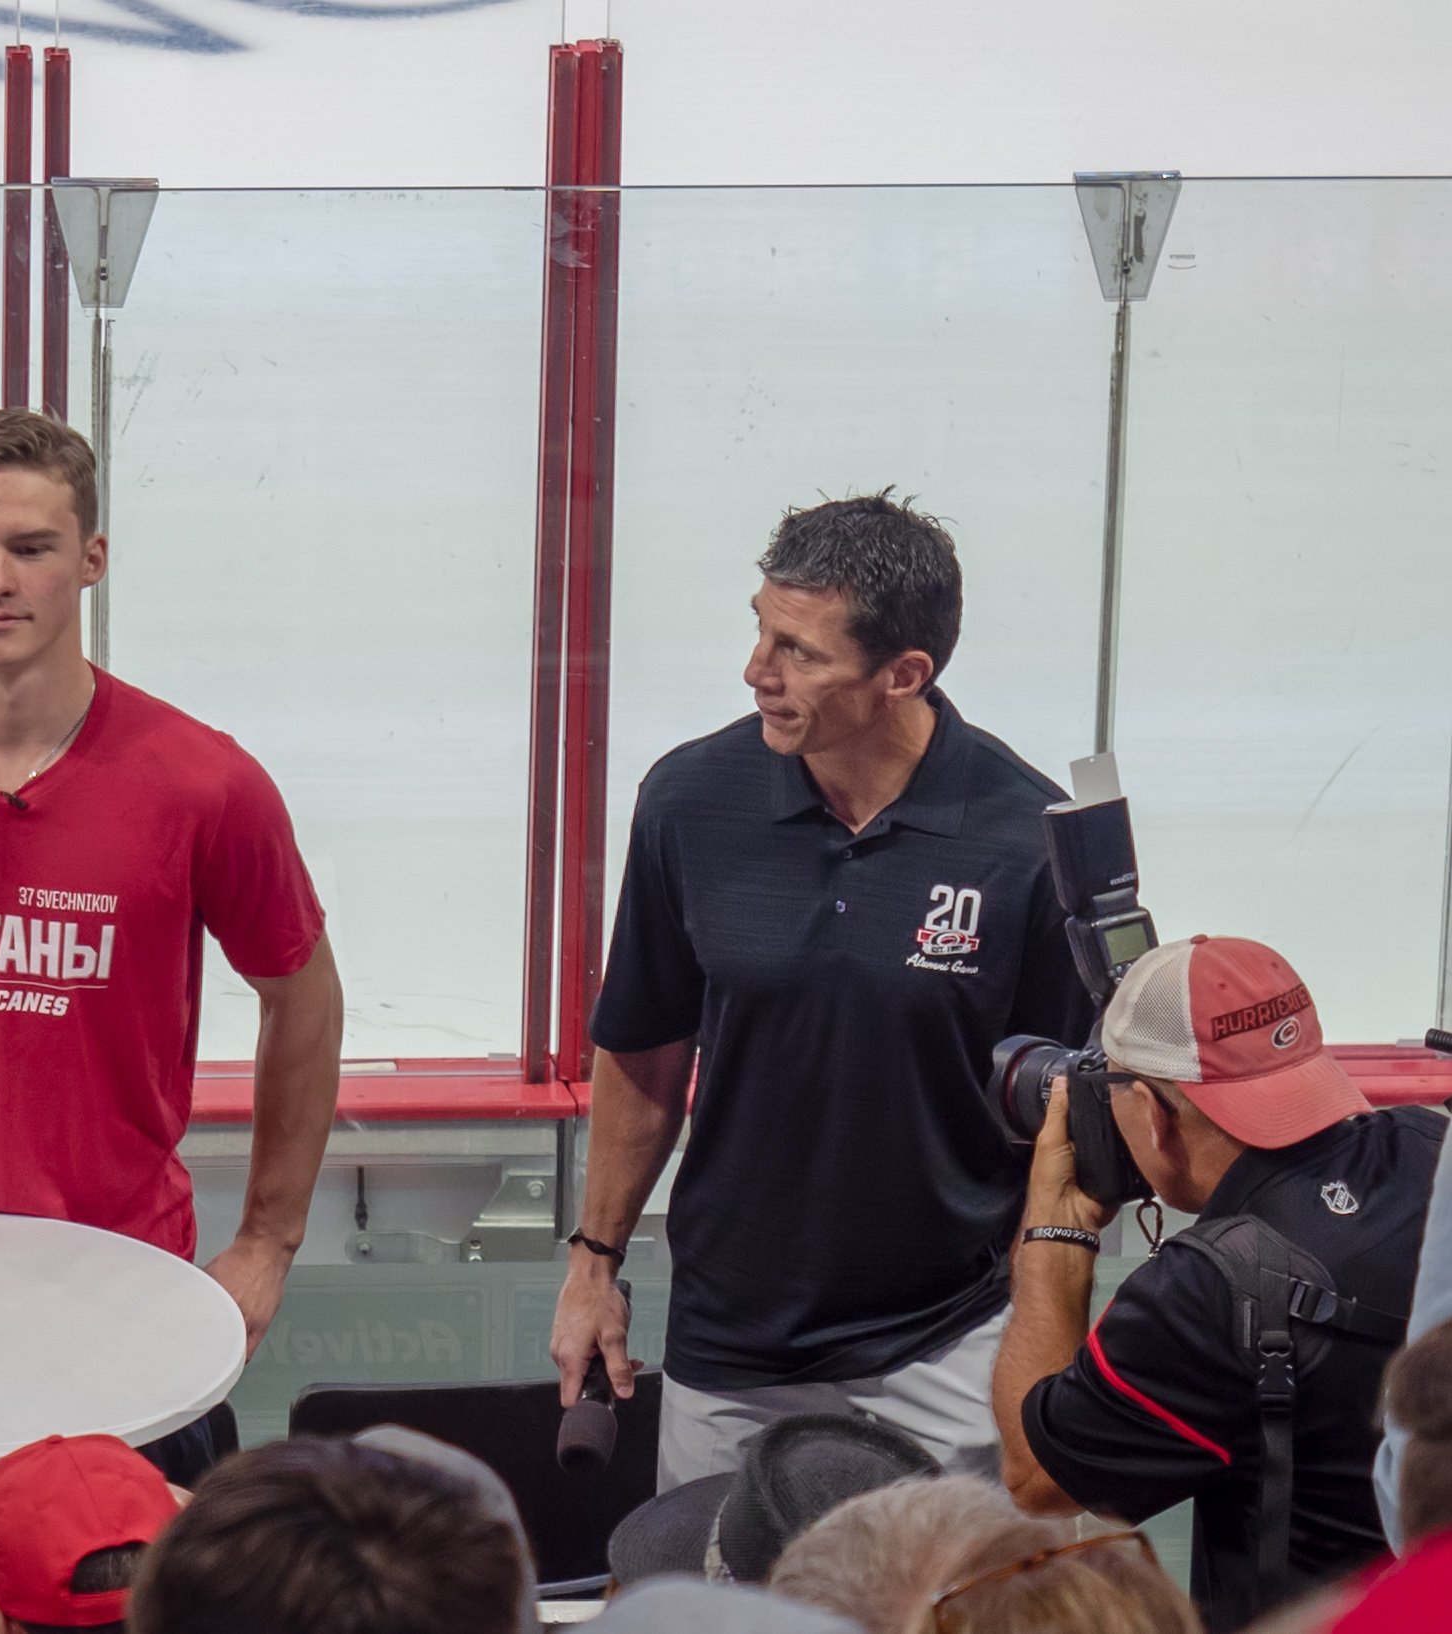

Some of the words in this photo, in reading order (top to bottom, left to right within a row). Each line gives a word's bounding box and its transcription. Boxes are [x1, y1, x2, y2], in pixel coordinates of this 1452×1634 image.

[18, 887, 34, 906] 37
[36, 888, 118, 914] SVECHNIKOV
[924, 884, 982, 937] 20
[905, 952, 950, 972] Alumni
